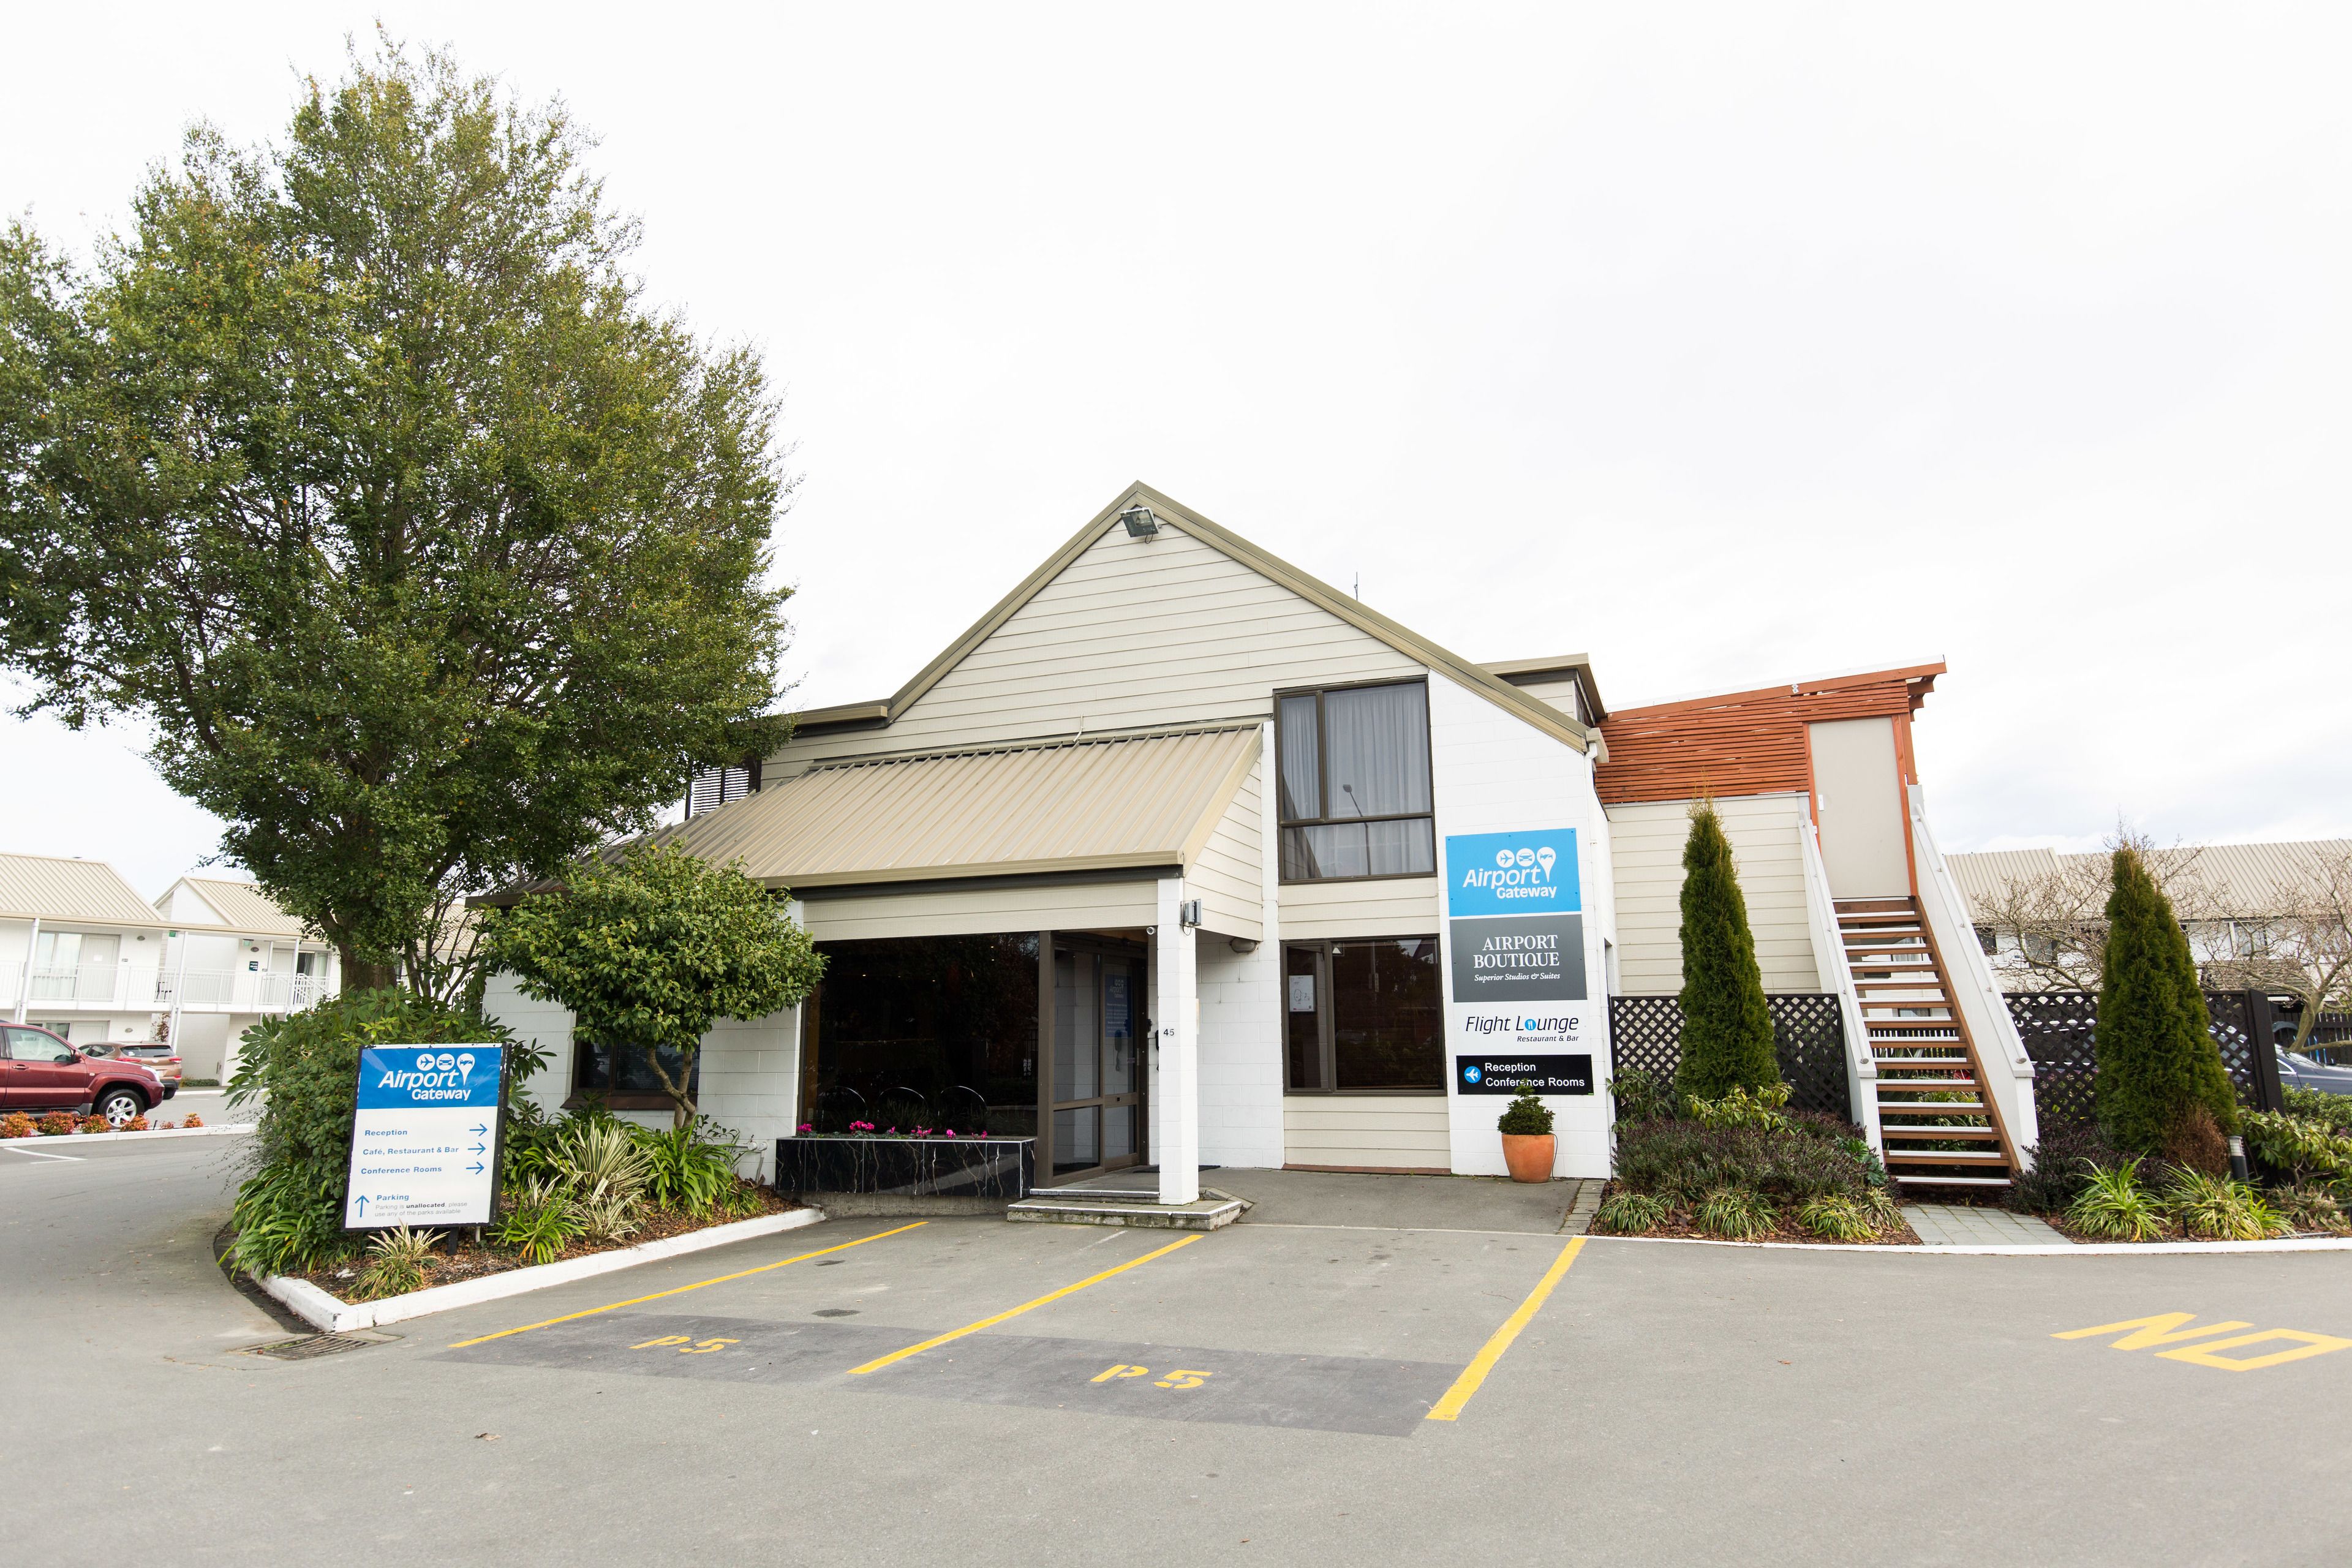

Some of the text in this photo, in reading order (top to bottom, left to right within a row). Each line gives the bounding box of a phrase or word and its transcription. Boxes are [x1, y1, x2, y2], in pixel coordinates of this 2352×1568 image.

[1462, 865, 1541, 889] Airport
[1496, 886, 1557, 899] Gateway
[1482, 935, 1558, 951] AIRPORT
[1473, 952, 1559, 968] BOUTIQUE
[1474, 974, 1504, 983] Superior
[1466, 1016, 1579, 1035] Flight Lounge
[1485, 1063, 1536, 1073] Reception
[378, 1069, 459, 1090] Airport
[1548, 1077, 1585, 1087] Rooms
[412, 1088, 471, 1101] Gateway
[2049, 1312, 2352, 1372] NO
